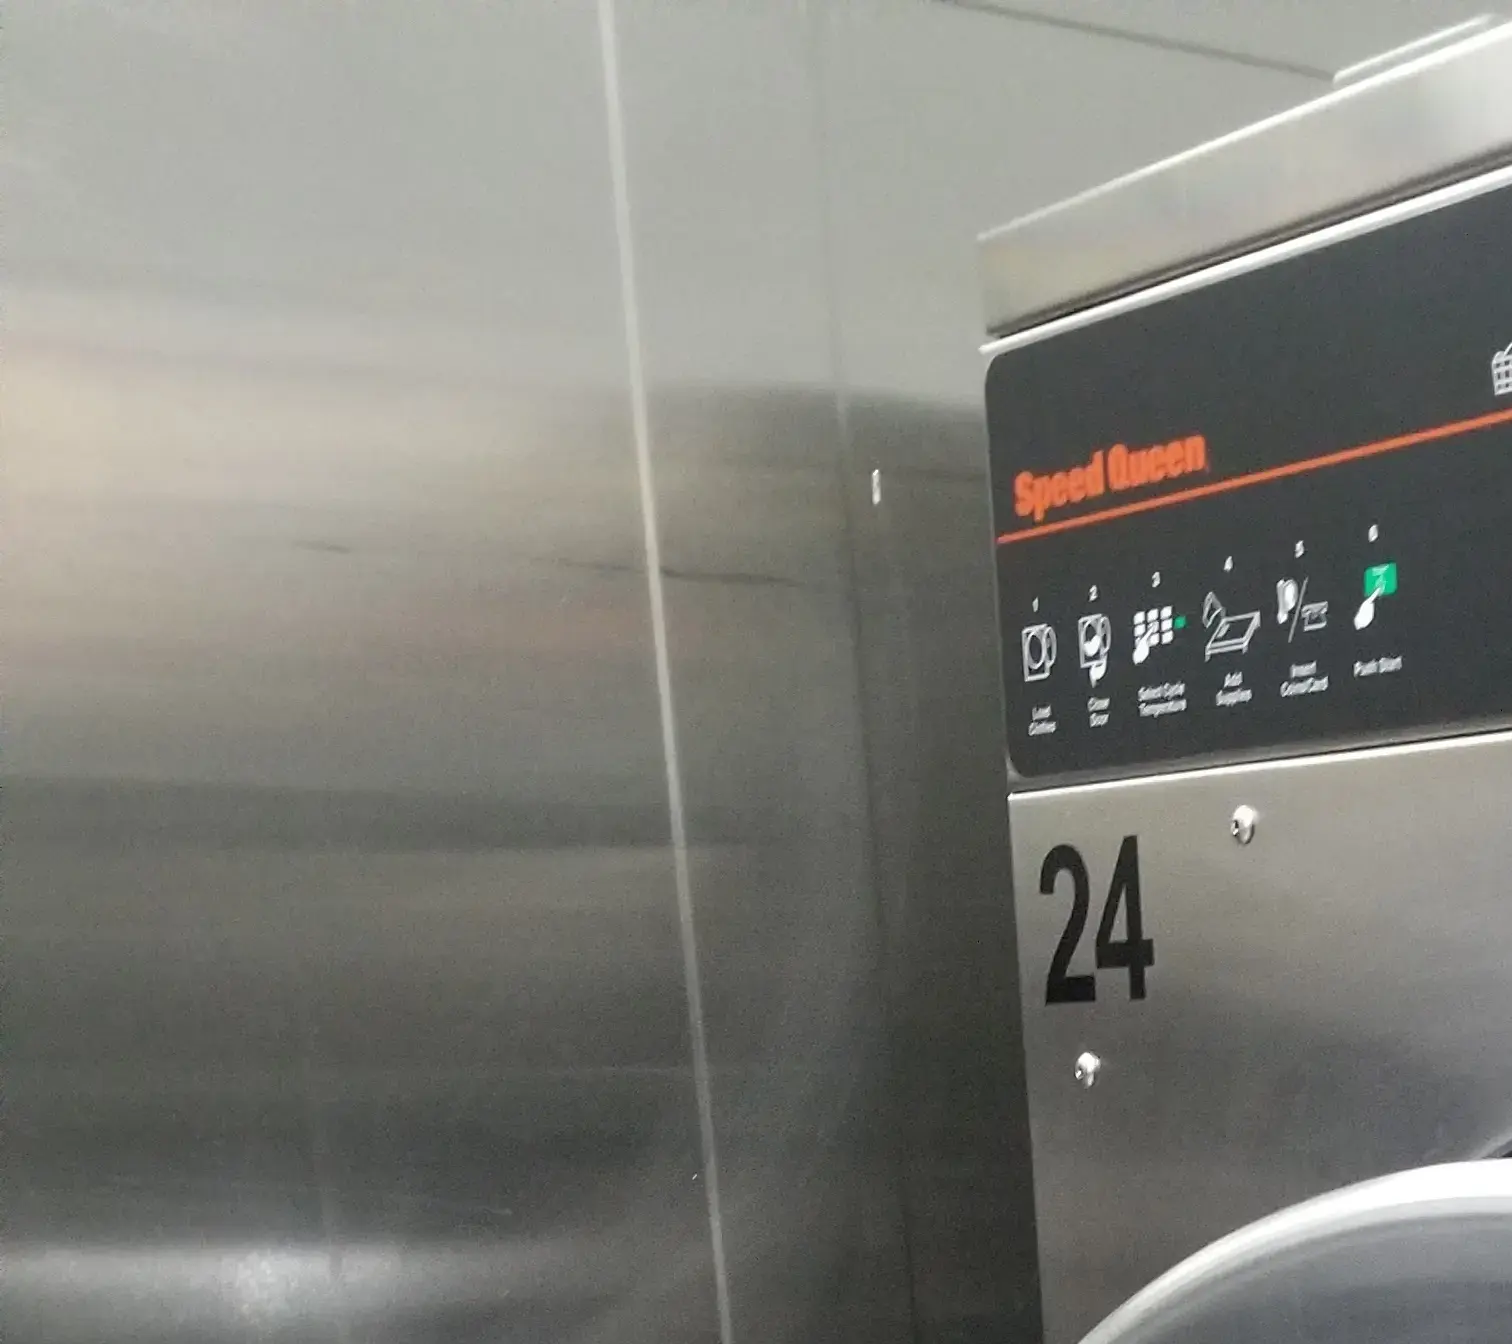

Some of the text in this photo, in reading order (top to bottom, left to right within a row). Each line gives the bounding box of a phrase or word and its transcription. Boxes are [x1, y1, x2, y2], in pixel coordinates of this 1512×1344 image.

[1014, 434, 1206, 523] Speed Queen
[1088, 584, 1098, 602] 2
[1151, 571, 1161, 588] 3
[1039, 834, 1155, 1007] 24
